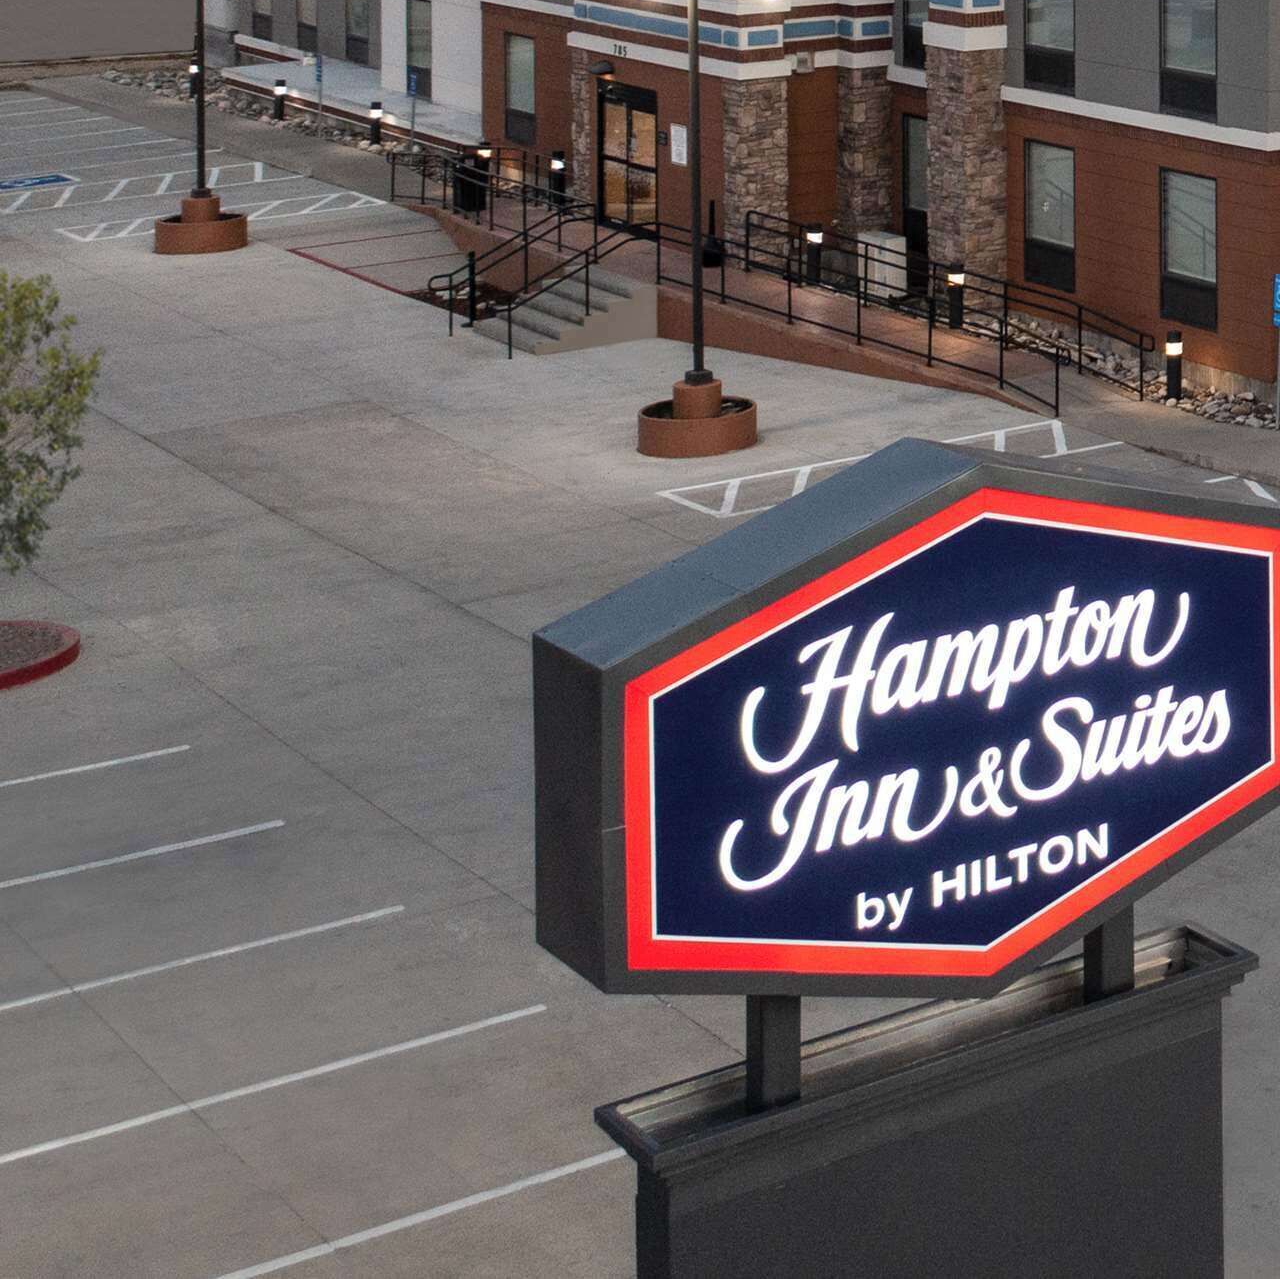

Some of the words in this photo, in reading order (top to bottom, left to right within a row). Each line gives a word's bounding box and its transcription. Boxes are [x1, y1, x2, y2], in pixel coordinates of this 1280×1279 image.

[739, 586, 1189, 776] Hampton
[718, 758, 959, 893] Inn
[957, 746, 1018, 818] &
[1009, 686, 1232, 802] Suites
[855, 891, 914, 931] by
[931, 822, 1110, 909] HILTON
